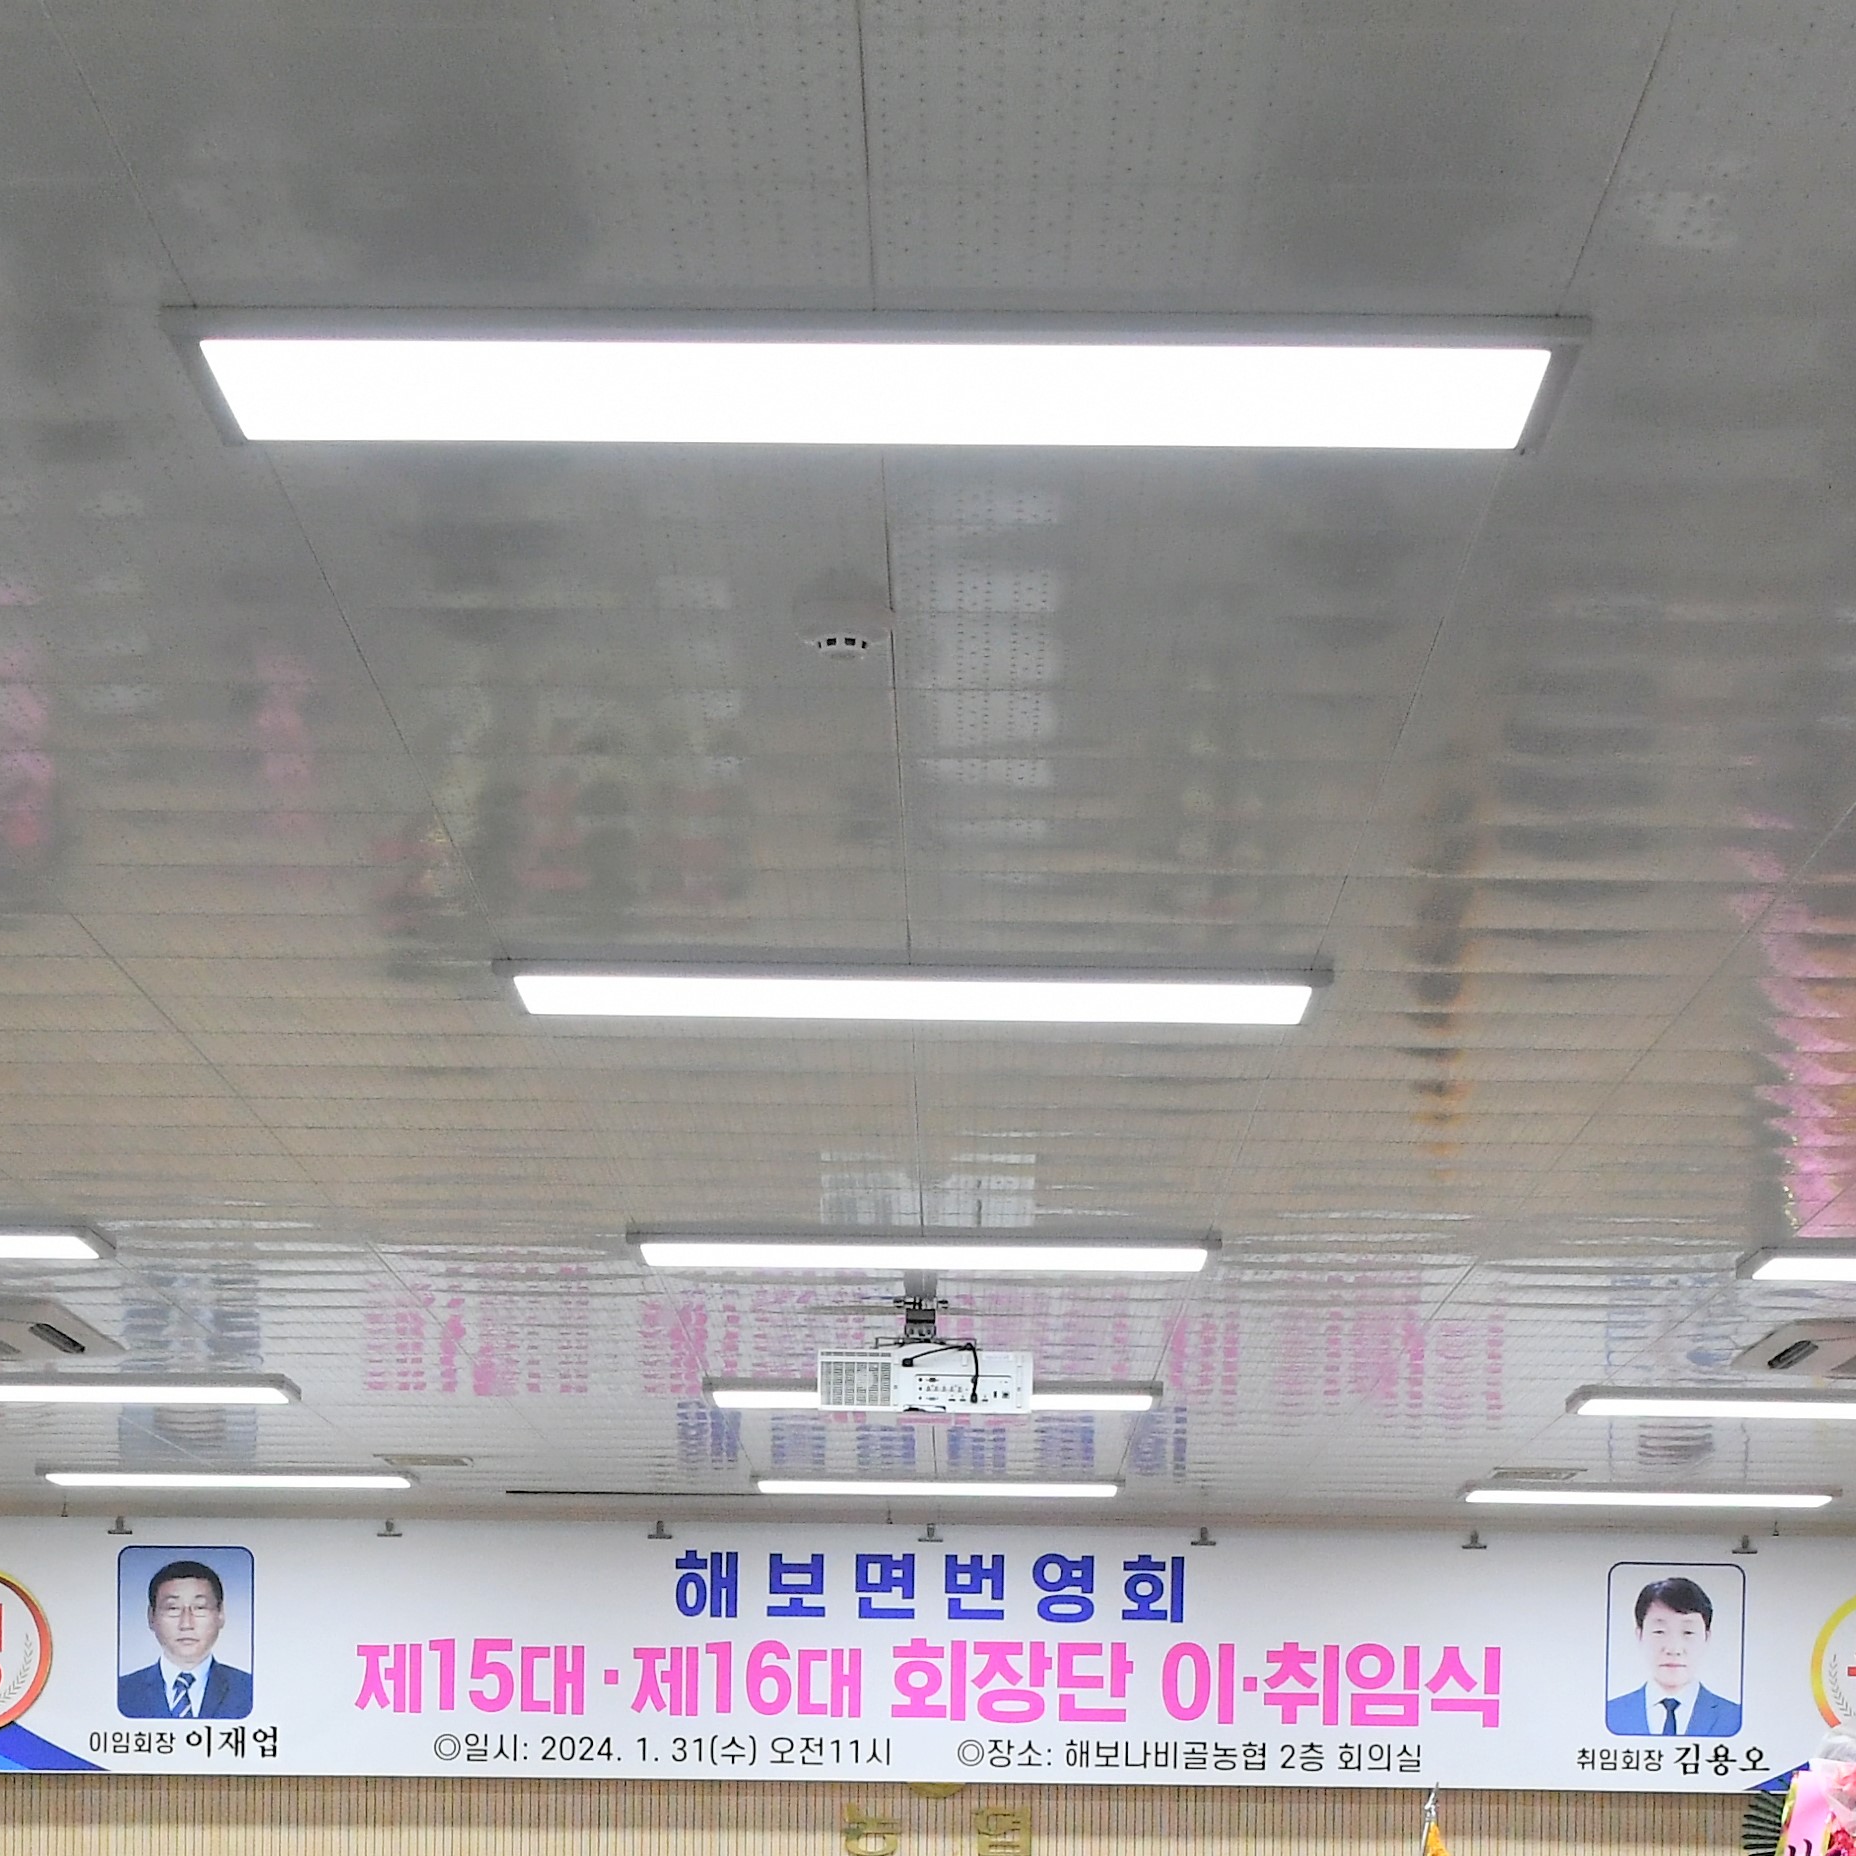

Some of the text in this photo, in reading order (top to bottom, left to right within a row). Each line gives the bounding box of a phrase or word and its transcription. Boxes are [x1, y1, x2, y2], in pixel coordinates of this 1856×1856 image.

[675, 1550, 1185, 1624] 해보면번영회
[890, 1637, 1134, 1724] 회장단
[1161, 1641, 1502, 1729] 이·취임식
[88, 1725, 279, 1759] 이임회장 이재업
[540, 1736, 622, 1762] 2024.
[635, 1737, 659, 1762] 1.
[670, 1734, 757, 1767] 31(수)
[769, 1737, 891, 1767] 오전11시
[1065, 1739, 1266, 1772] 해보나비골농협
[1279, 1742, 1325, 1772] 2층
[1337, 1743, 1422, 1774] 회의실
[1575, 1743, 1771, 1777] 취임회장 김용오
